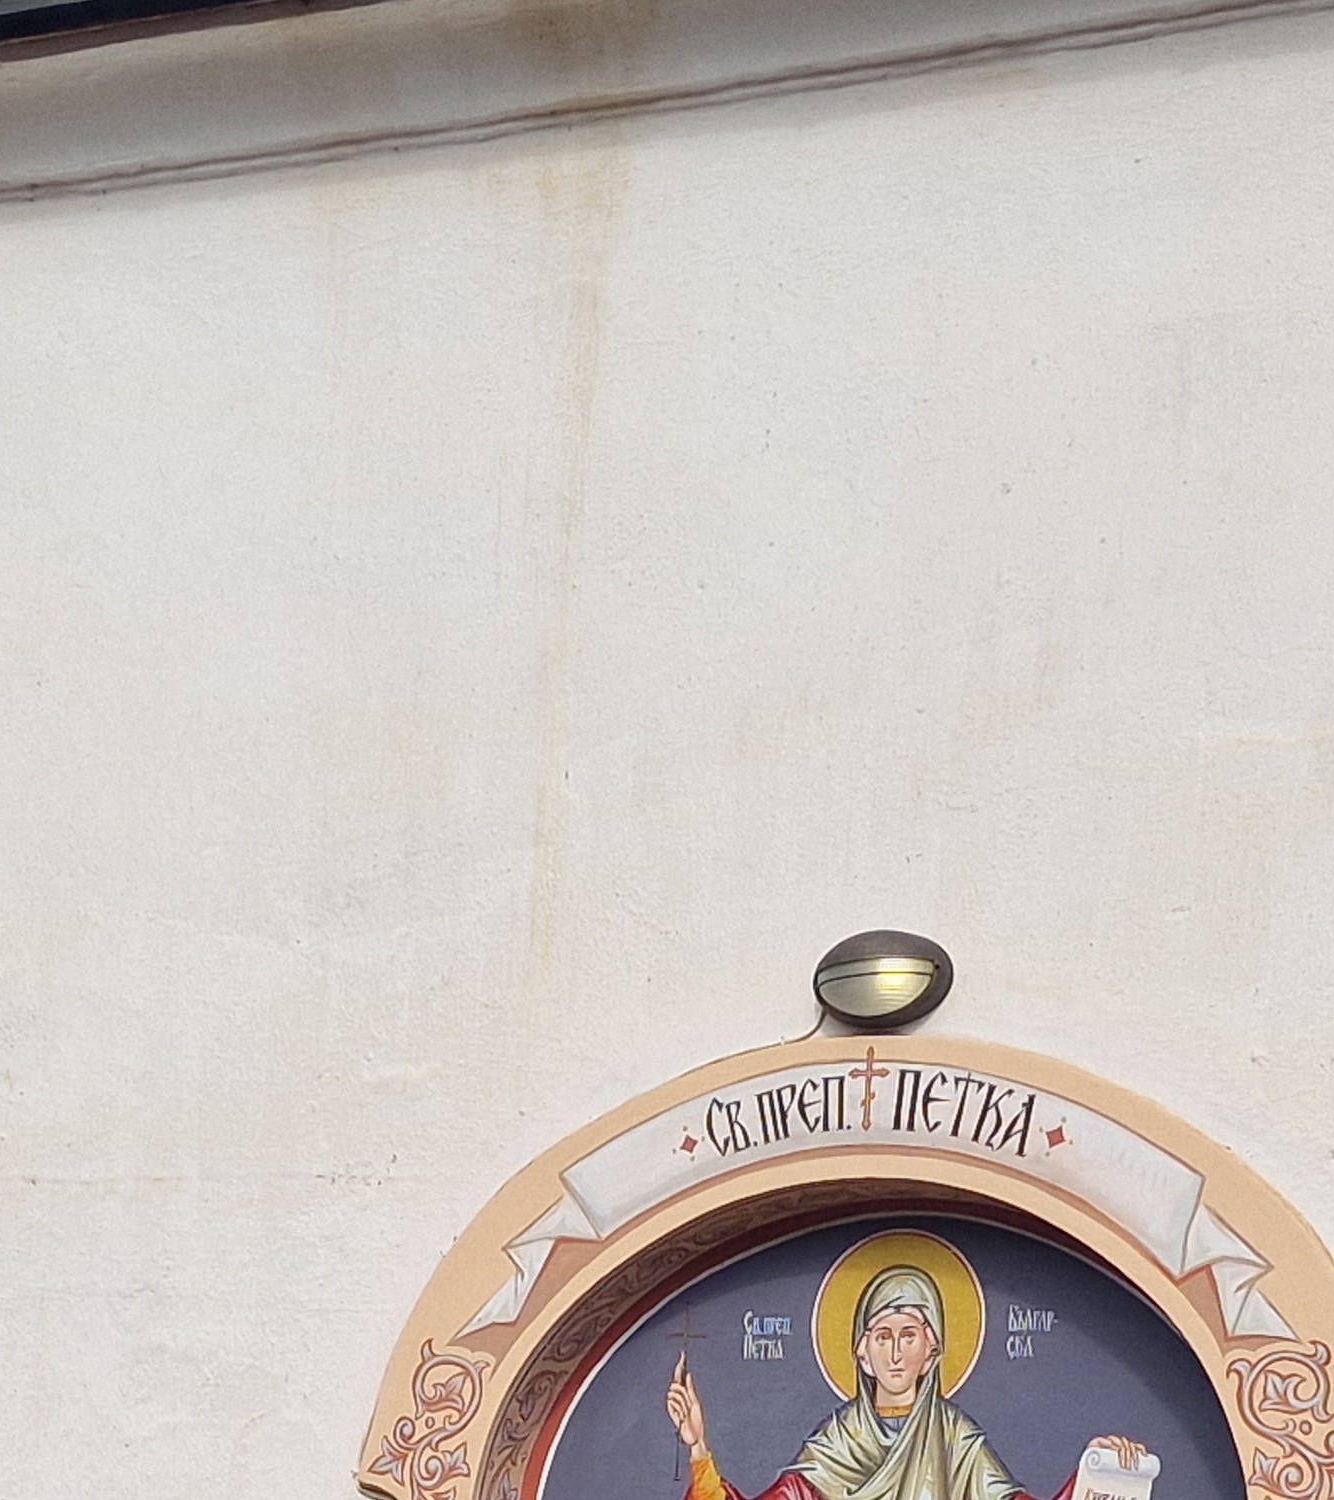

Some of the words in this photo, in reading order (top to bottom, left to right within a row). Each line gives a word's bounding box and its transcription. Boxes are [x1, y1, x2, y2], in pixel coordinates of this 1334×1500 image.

[705, 1096, 758, 1157] СВ.
[755, 1075, 852, 1144] ПРЕП.
[891, 1068, 1037, 1157] ПЕТКА
